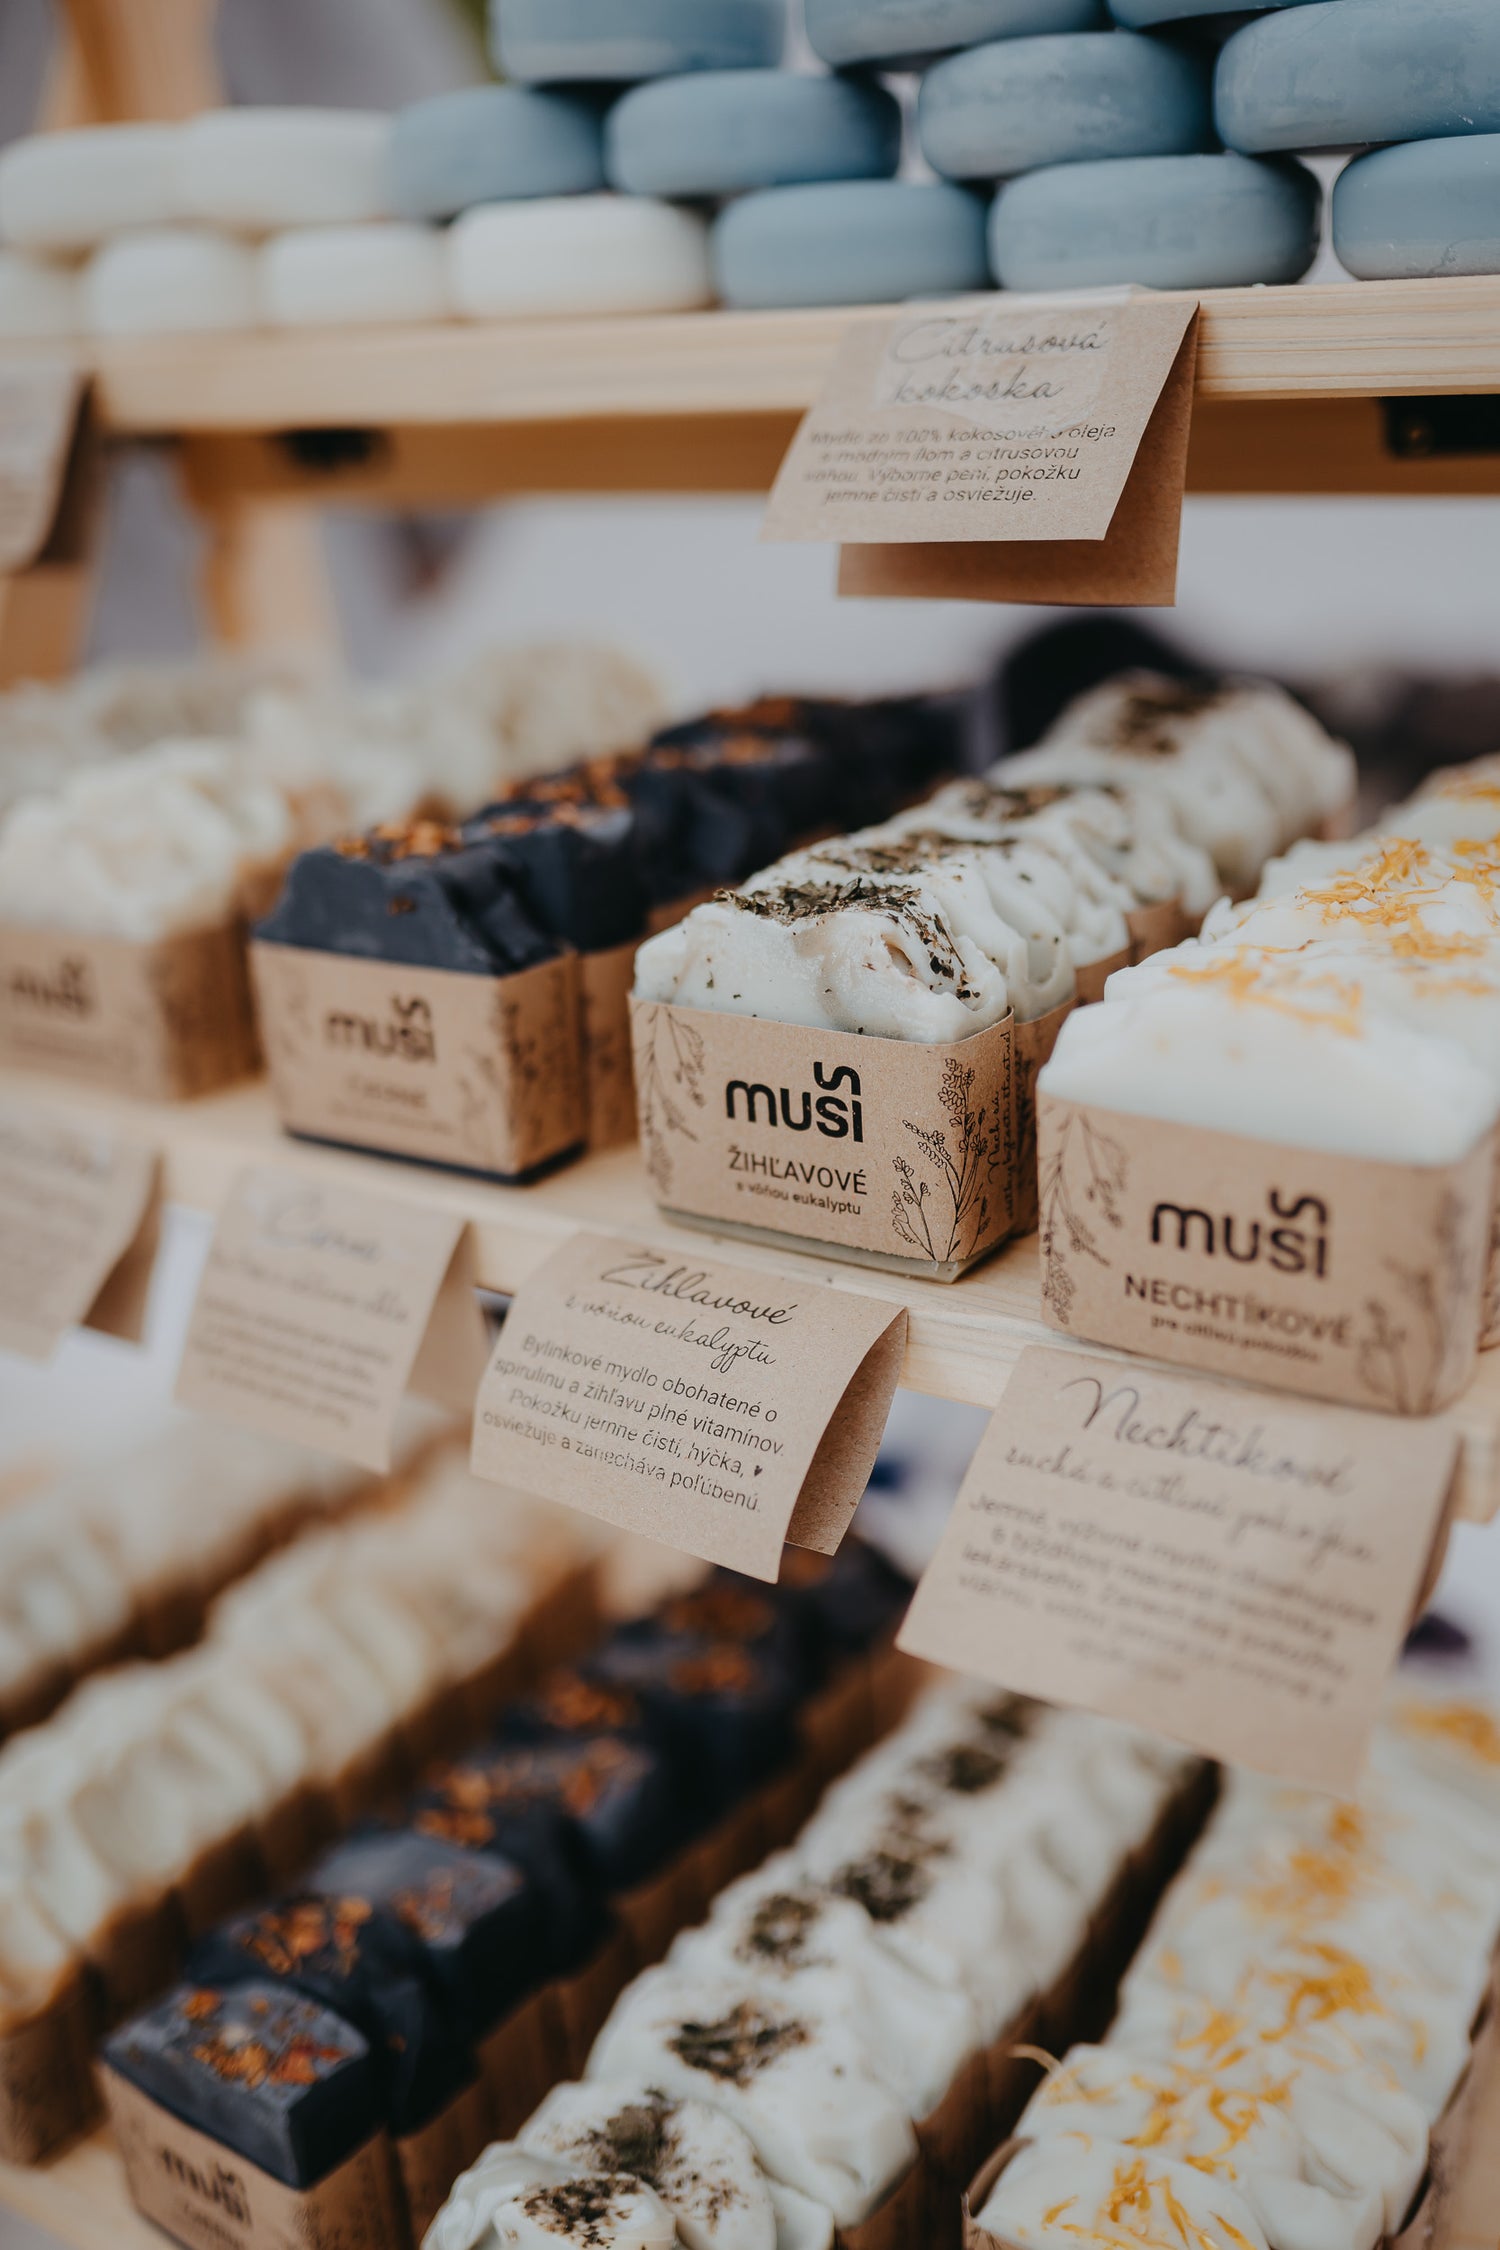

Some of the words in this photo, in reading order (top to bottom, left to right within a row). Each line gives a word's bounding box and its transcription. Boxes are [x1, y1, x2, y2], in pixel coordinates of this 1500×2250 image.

[1067, 424, 1117, 441] oleja
[959, 450, 971, 461] a
[976, 446, 1080, 461] citrusovou
[995, 464, 1082, 484] pokožku
[926, 490, 939, 502] a
[943, 485, 1038, 504] osviežuje.
[728, 1144, 868, 1196] ŽIHĽAVOVÉ
[792, 1192, 861, 1215] eukalyptu
[654, 1318, 777, 1374] eukalyptu
[522, 1334, 602, 1372] Bylinkové
[604, 1361, 658, 1387] mydlo
[662, 1377, 762, 1418] obohatené
[765, 1409, 778, 1423] o
[494, 1358, 567, 1391] spirulinu
[568, 1380, 580, 1394] a
[583, 1381, 646, 1414] žihľavu
[647, 1402, 688, 1427] plné
[693, 1415, 785, 1457] vitamínov.
[482, 1410, 557, 1446] osviežuje
[560, 1436, 571, 1450] a
[508, 1387, 583, 1425] Pokožku
[583, 1415, 639, 1442] jemne
[687, 1441, 745, 1479] hýčka,
